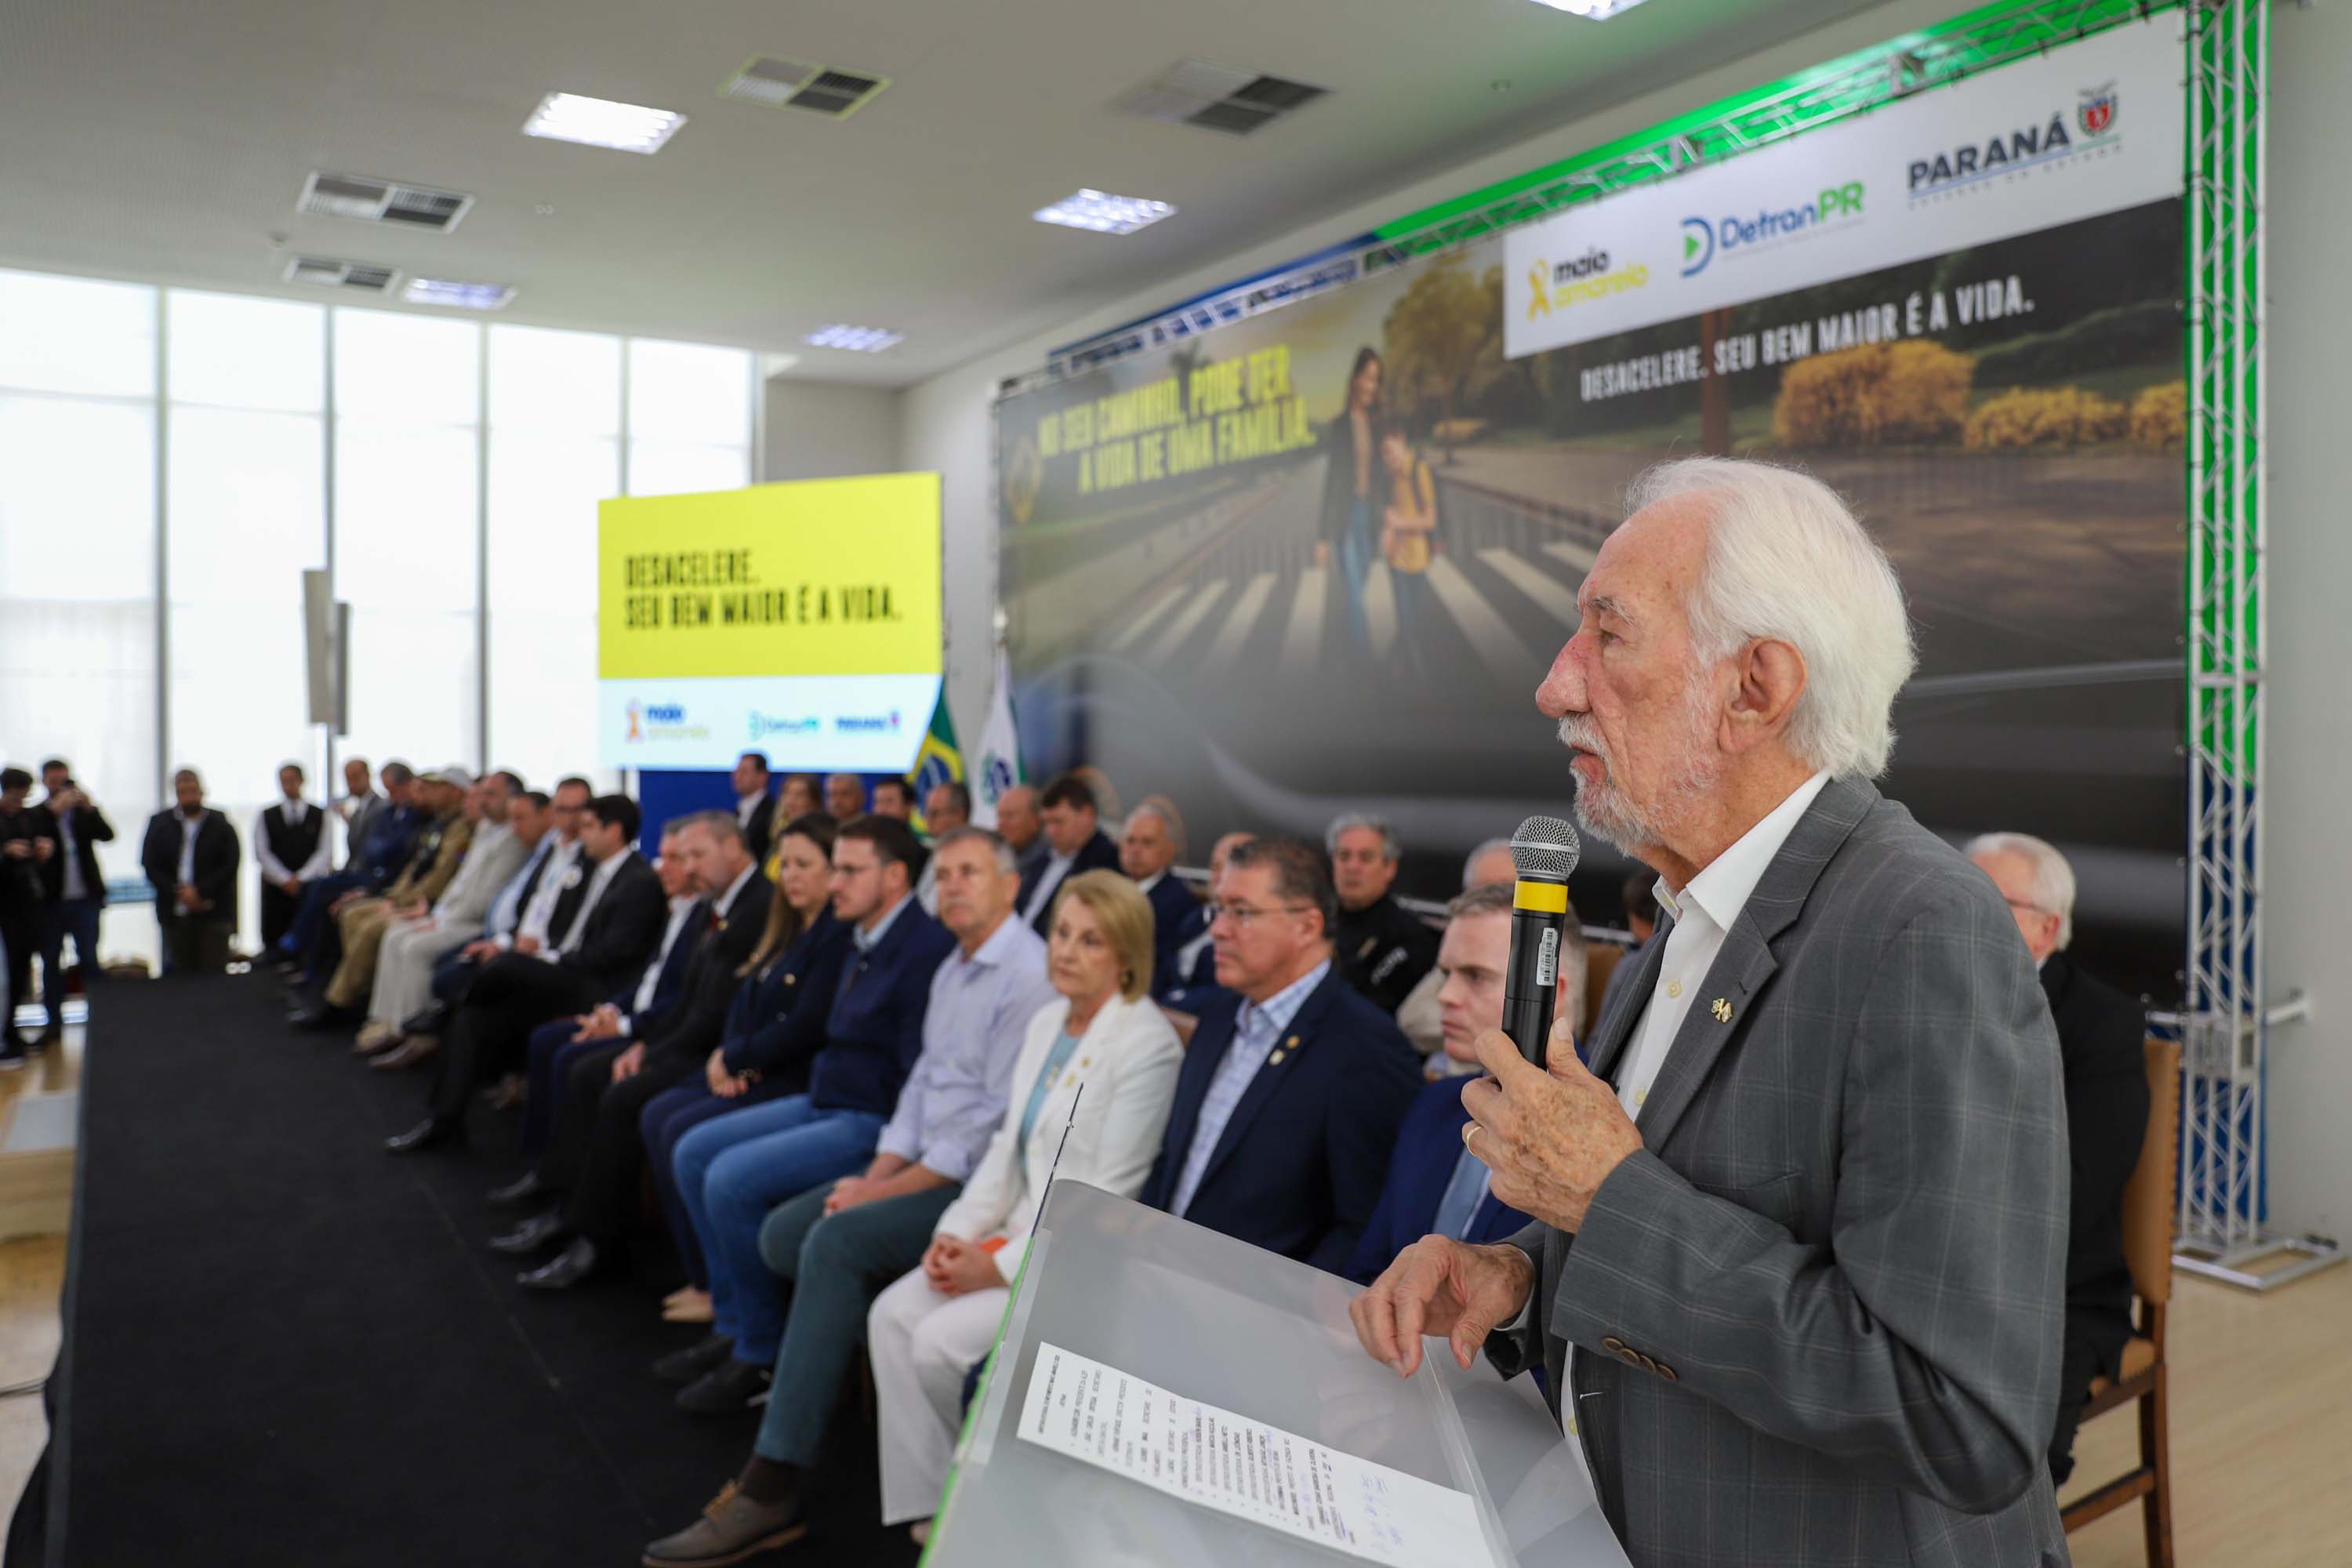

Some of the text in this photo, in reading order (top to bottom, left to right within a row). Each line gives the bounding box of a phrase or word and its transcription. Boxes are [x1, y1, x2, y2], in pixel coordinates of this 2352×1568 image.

[1907, 112, 2071, 191] PARANÁ
[1720, 181, 1864, 249] DetranPR
[1554, 247, 1611, 285] maio
[1554, 262, 1650, 308] amarelo
[1580, 274, 2035, 402] DESACELERE. SEU BEM MAIOR É A VIDA.
[1064, 402, 1094, 452] SEU
[1190, 358, 1244, 419] PODE
[1248, 345, 1290, 404] TER
[1079, 450, 1094, 495] A
[1096, 438, 1137, 492] VIDA
[1140, 431, 1165, 482] DE
[1167, 419, 1214, 475] UMA
[626, 550, 761, 588] DESACELERE.
[626, 583, 903, 628] SEU BEM MAIOR É A VIDA.
